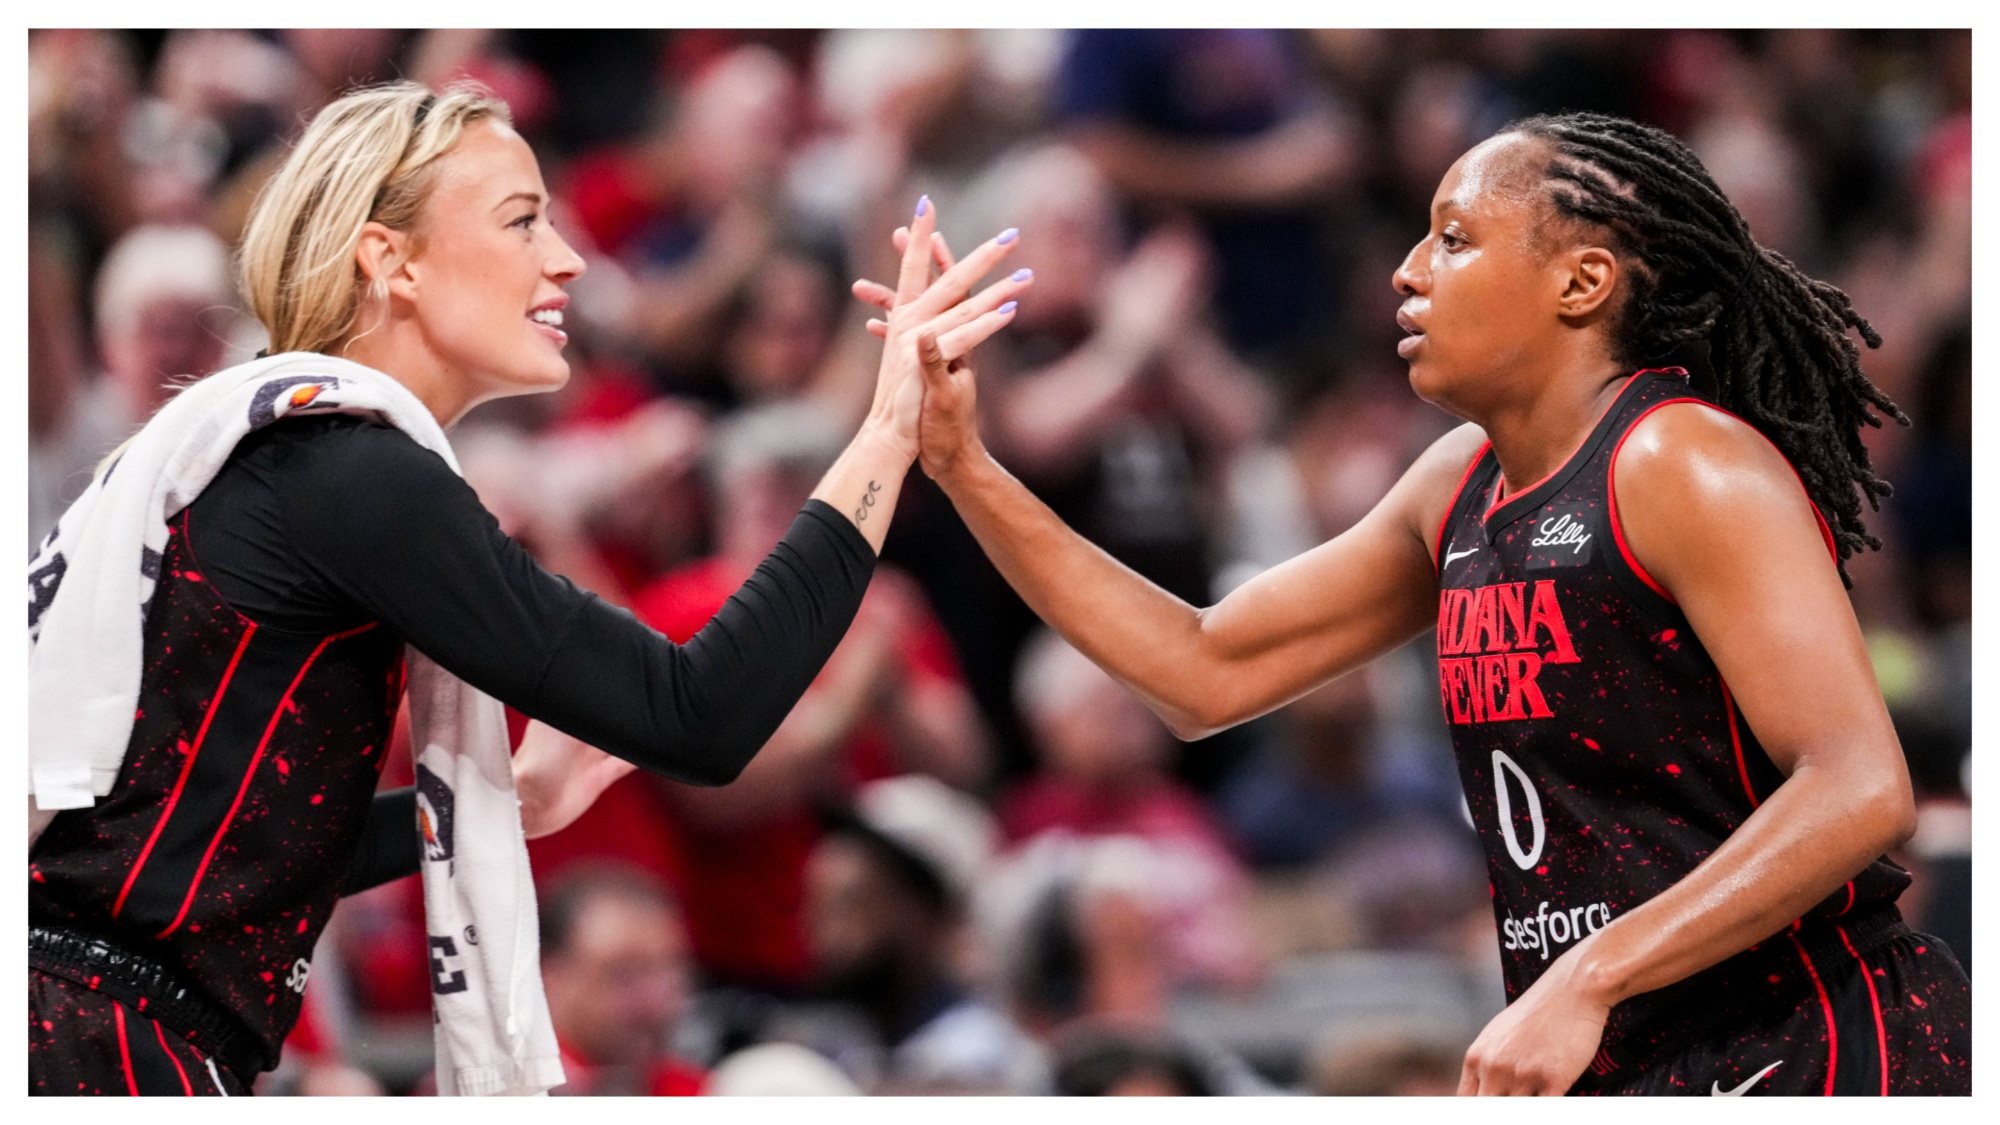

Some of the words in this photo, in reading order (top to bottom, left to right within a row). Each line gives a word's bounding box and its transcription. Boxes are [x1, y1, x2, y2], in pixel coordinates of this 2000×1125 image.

[1531, 513, 1592, 554] Lilly
[1437, 579, 1582, 665] NDIANA
[1439, 652, 1555, 725] FEVER
[1491, 749, 1546, 870] 0
